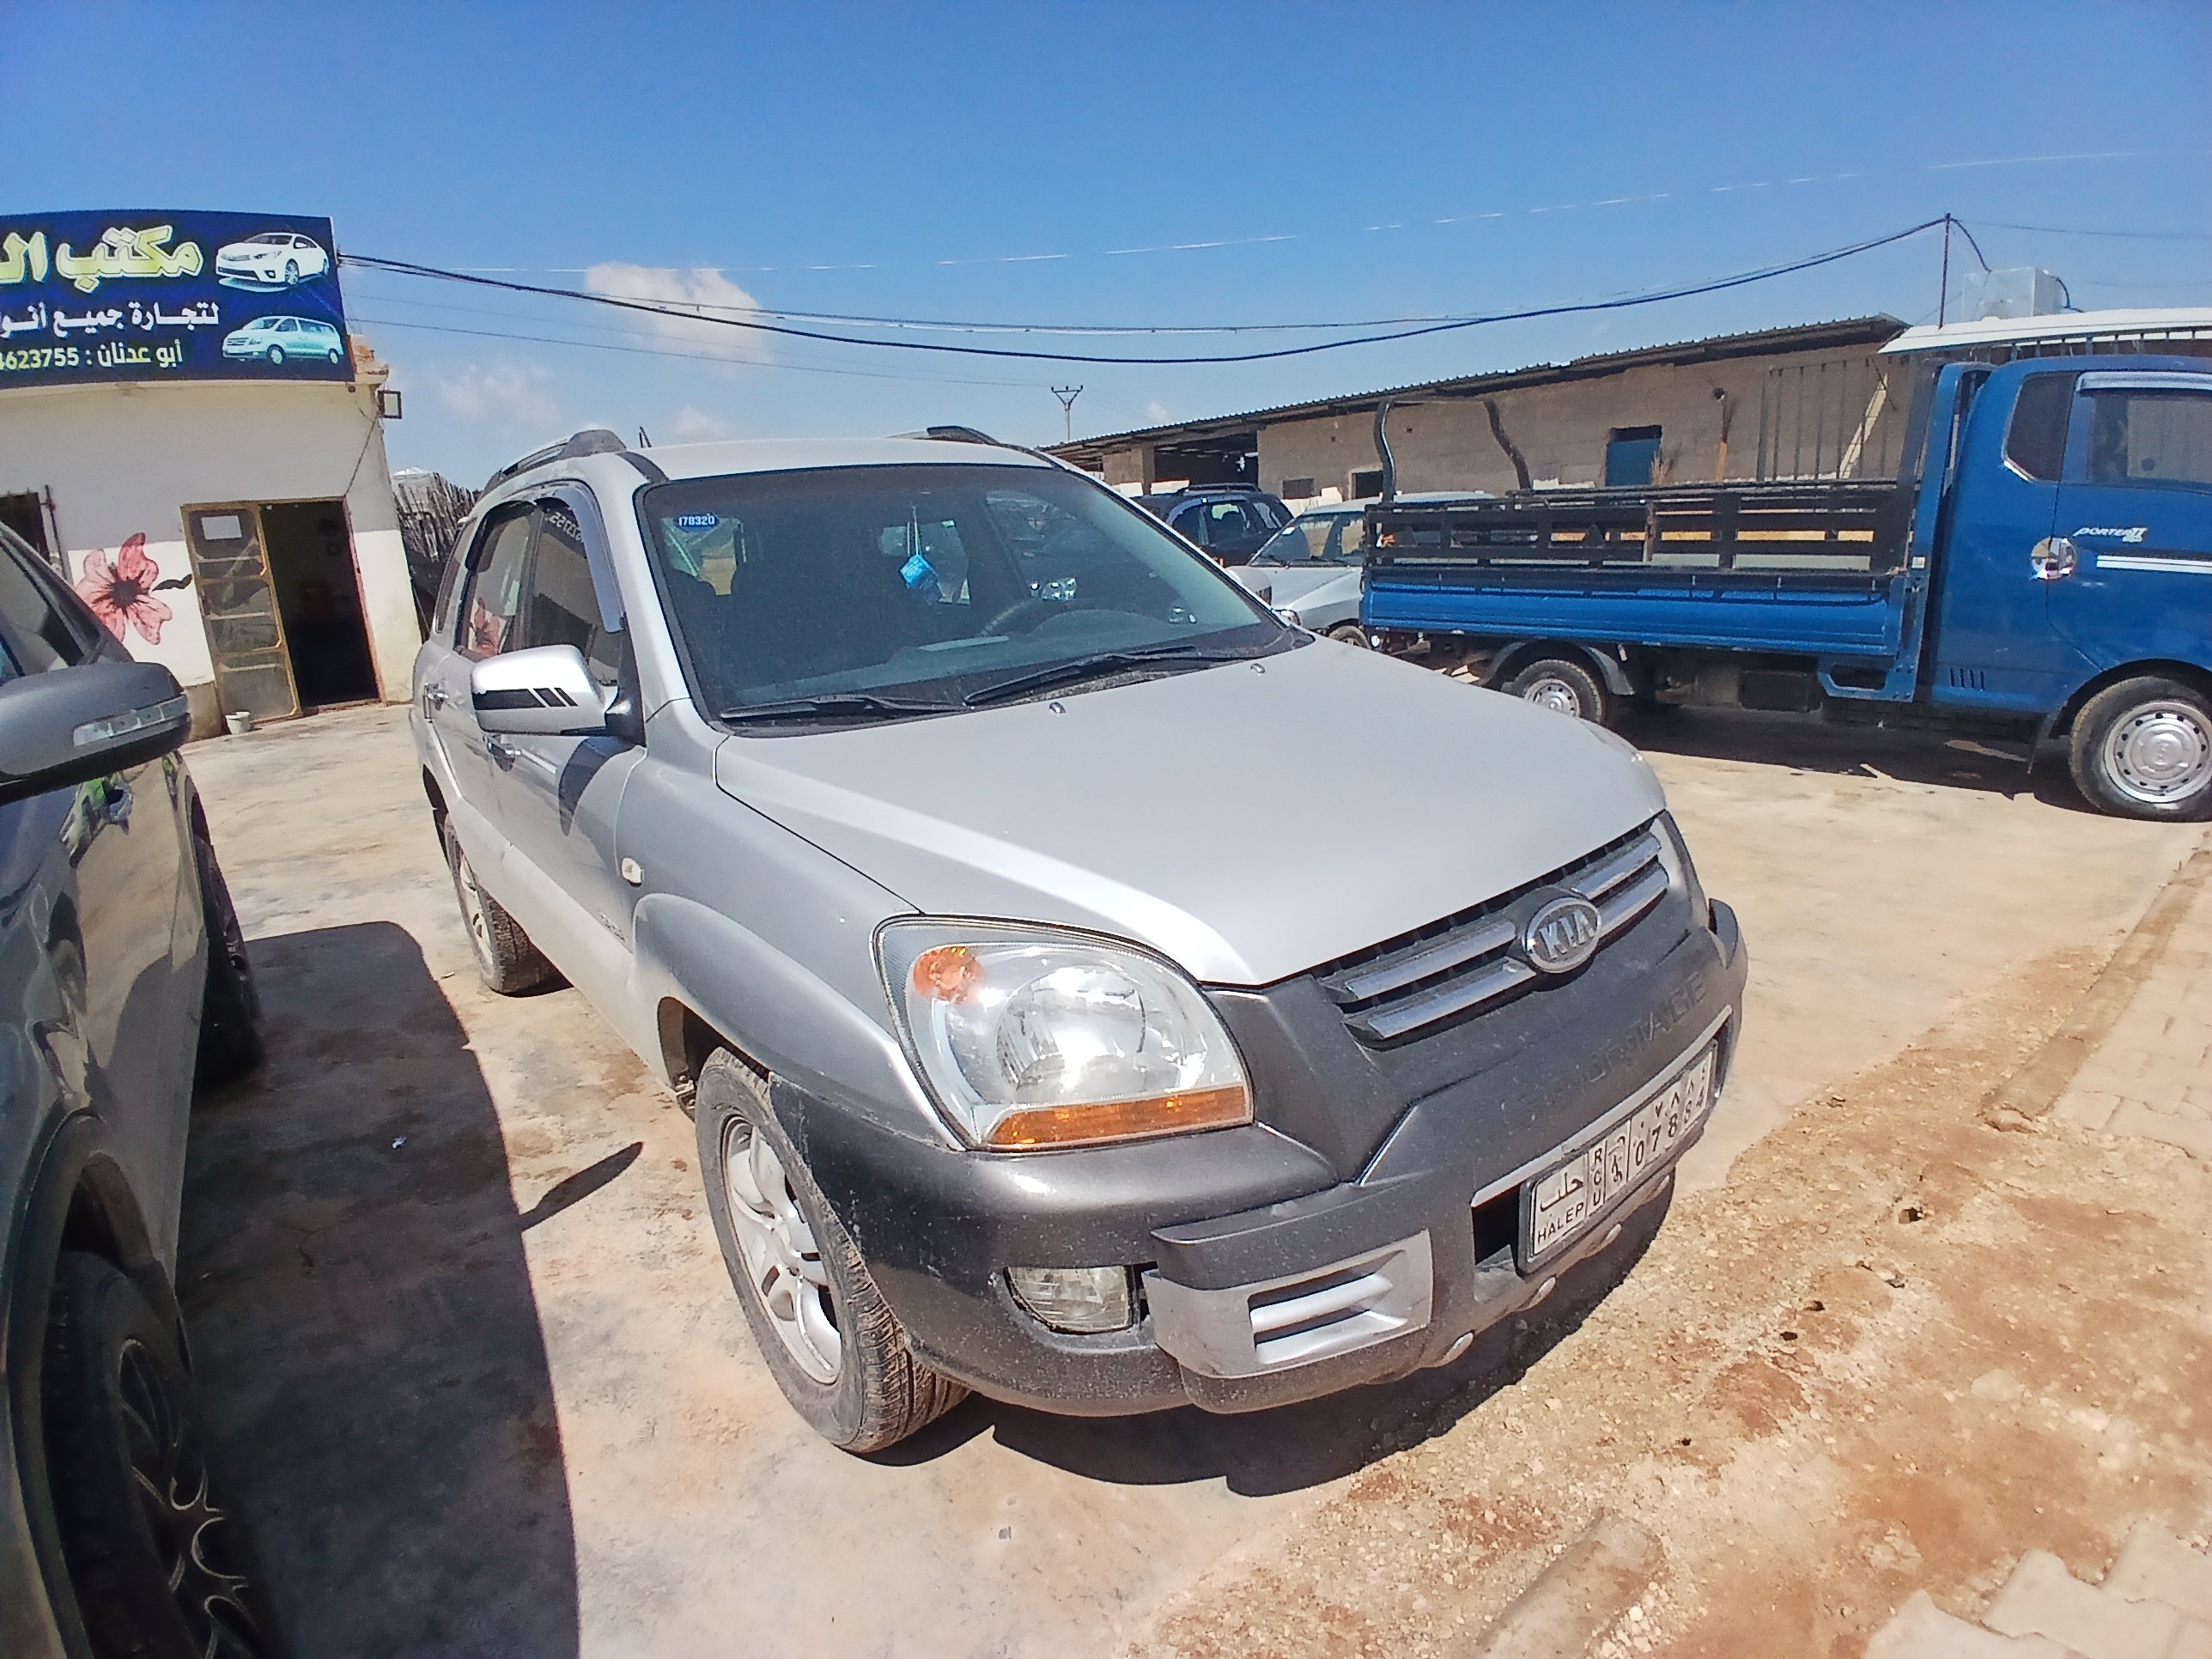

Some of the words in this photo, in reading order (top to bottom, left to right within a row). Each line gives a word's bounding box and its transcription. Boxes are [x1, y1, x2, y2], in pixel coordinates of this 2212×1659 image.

[55, 224, 204, 294] مكتب
[53, 308, 124, 337] جميع
[128, 301, 219, 331] لتجارة
[96, 342, 151, 368] عدنان
[155, 338, 183, 368] أبو
[1538, 909, 1596, 960] KIA
[1540, 1171, 1584, 1218] حلب
[1537, 1201, 1584, 1245] HALEP
